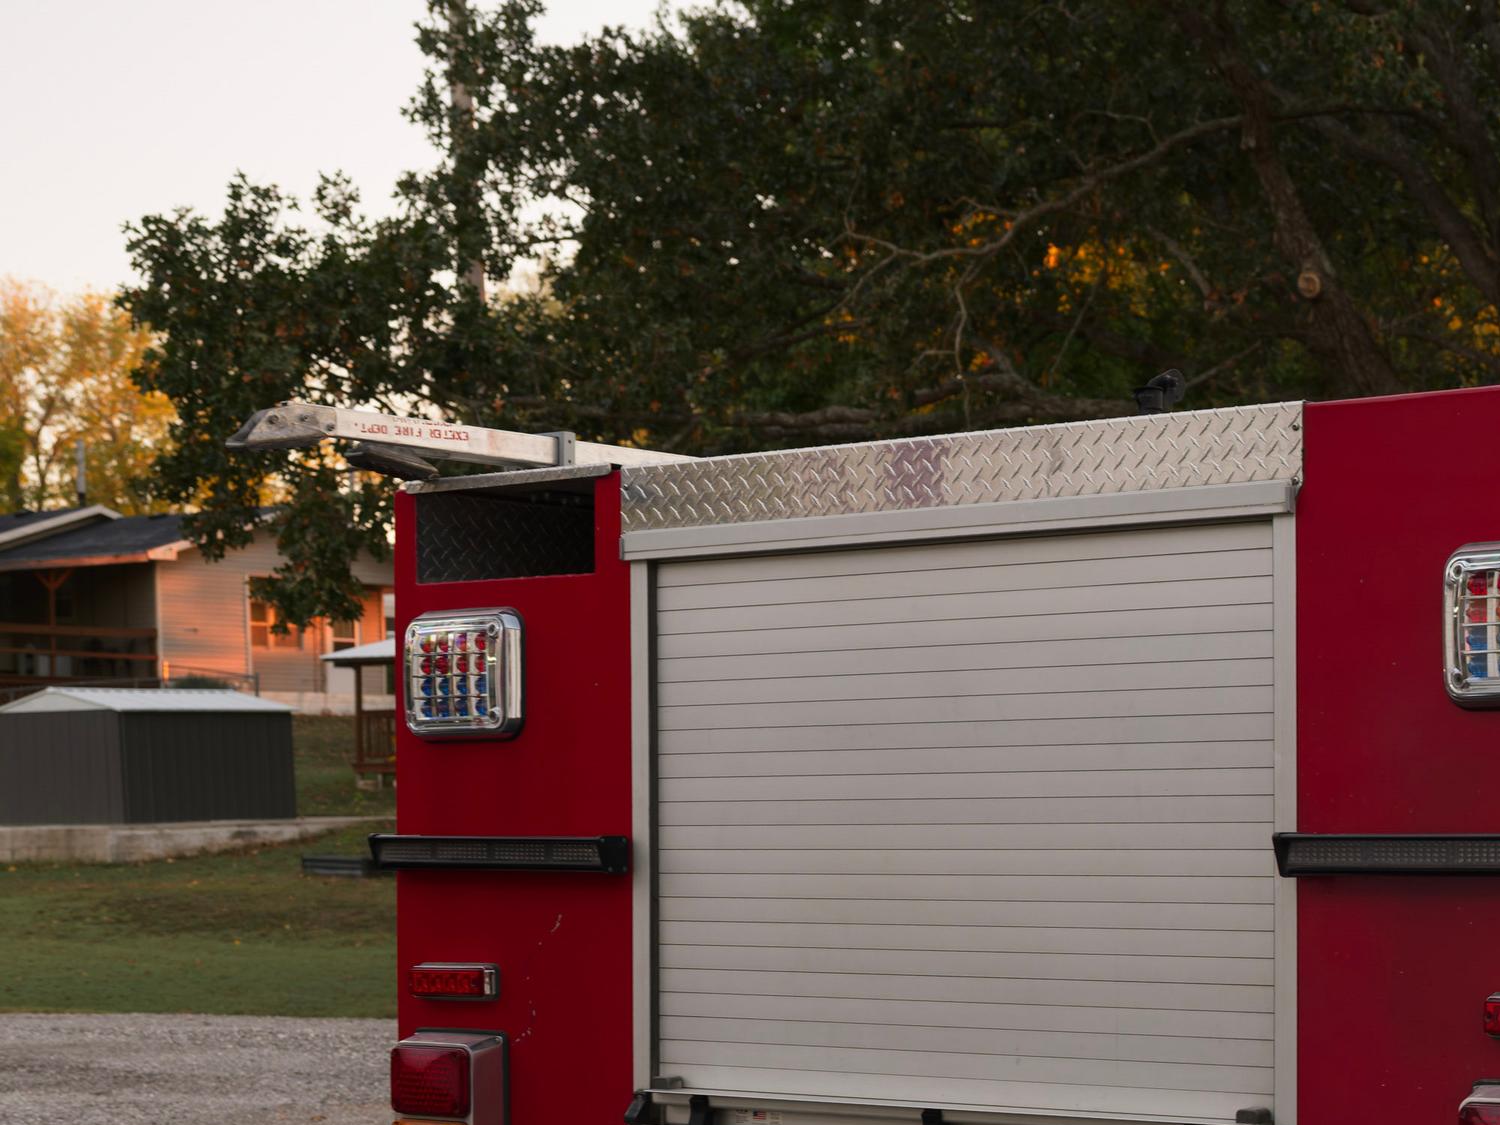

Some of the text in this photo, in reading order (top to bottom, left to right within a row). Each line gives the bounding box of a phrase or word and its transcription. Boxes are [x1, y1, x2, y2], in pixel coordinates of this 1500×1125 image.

[354, 422, 469, 441] EXETER FIRE DEPT.
